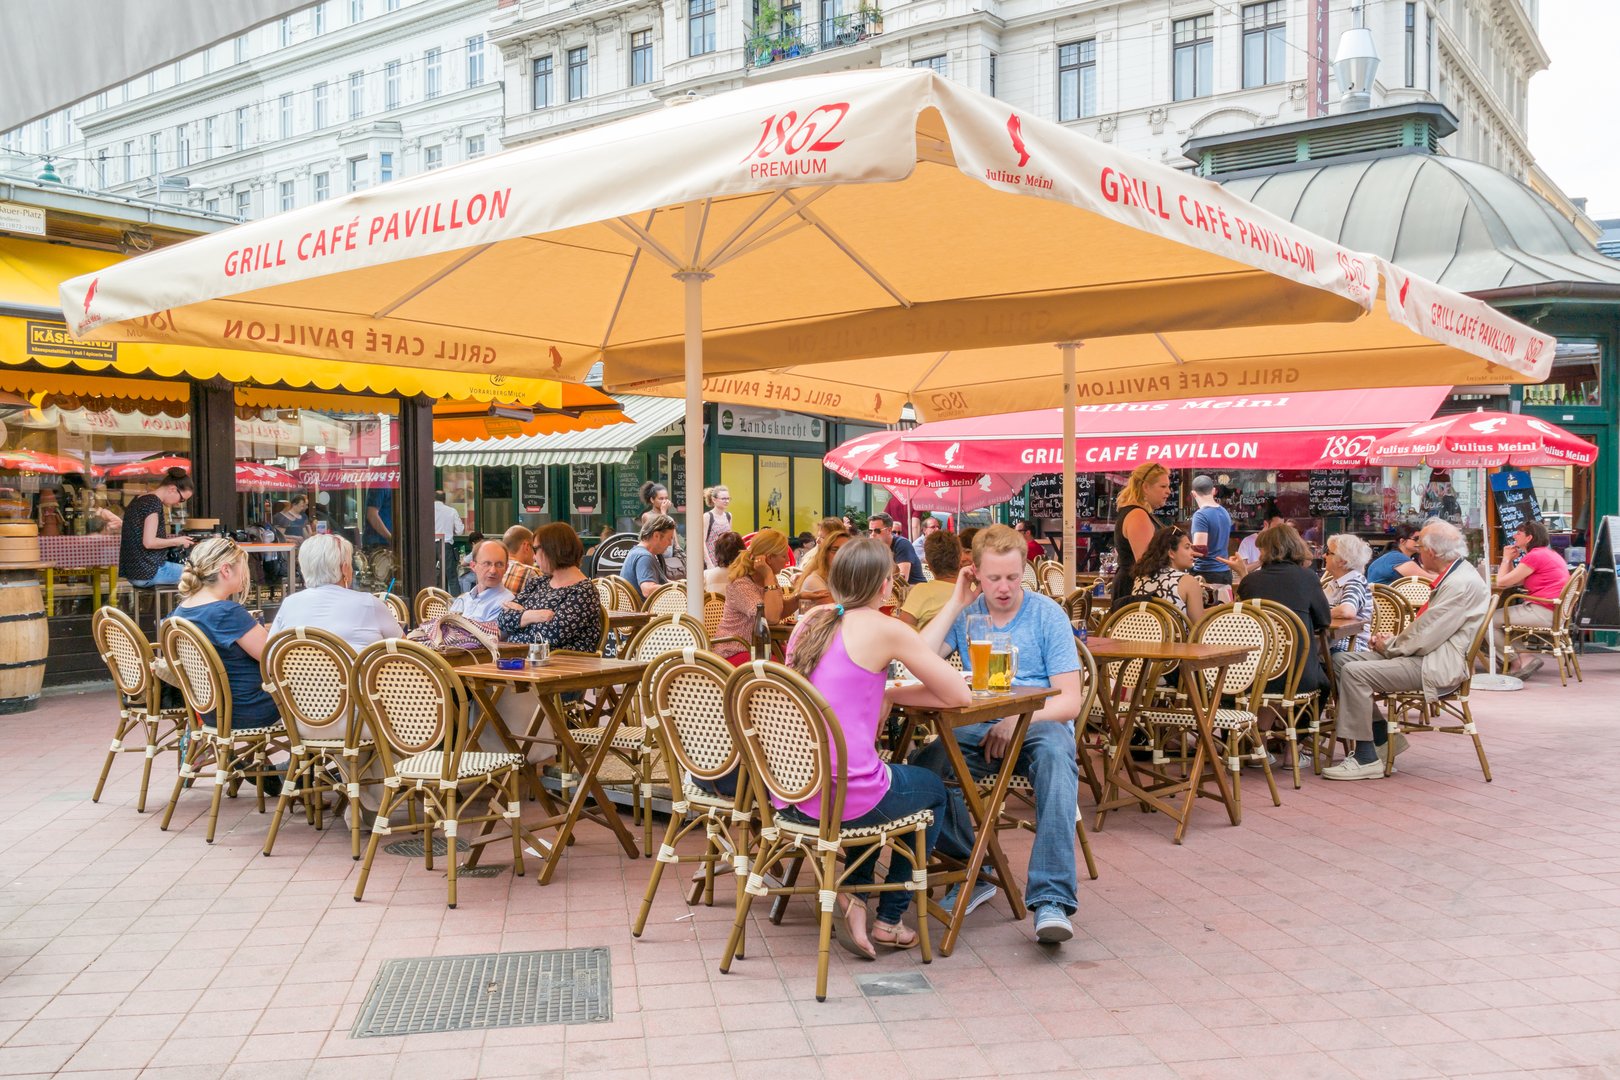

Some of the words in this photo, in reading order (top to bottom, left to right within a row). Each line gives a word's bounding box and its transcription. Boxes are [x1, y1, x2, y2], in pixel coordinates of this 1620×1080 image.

[739, 102, 850, 165] 1862
[750, 158, 827, 179] PREMIUM
[985, 168, 1021, 184] Julius
[1025, 174, 1053, 190] Meinl
[0, 206, 42, 219] auer-Platz
[1101, 167, 1170, 220] GRILL
[1178, 194, 1232, 241] CAFÉ
[1234, 216, 1316, 274] PAVILLON
[224, 239, 287, 277] GRILL
[297, 215, 359, 262] CAFÉ
[368, 187, 512, 246] PAVILLON
[1431, 303, 1455, 331] GRILL
[1455, 313, 1479, 341] CAFÉ
[1479, 323, 1517, 356] PAVILLON
[1057, 402, 1168, 412] ulius
[1178, 397, 1290, 411] Meinl
[739, 418, 806, 438] Landsknecht
[1021, 448, 1077, 464] GRIL
[1085, 443, 1139, 463] CAFÉ
[1146, 442, 1258, 460] PAVILLON
[1320, 435, 1376, 459] 1862
[1376, 444, 1409, 454] Julius
[1411, 443, 1440, 453] Meinl
[1451, 442, 1493, 452] Julius
[1497, 442, 1537, 452] Meinl
[1566, 450, 1590, 463] Meinl
[862, 474, 891, 483] Julius
[893, 475, 918, 486] Meinl
[926, 480, 949, 488] Julius
[951, 479, 973, 487] Meinl
